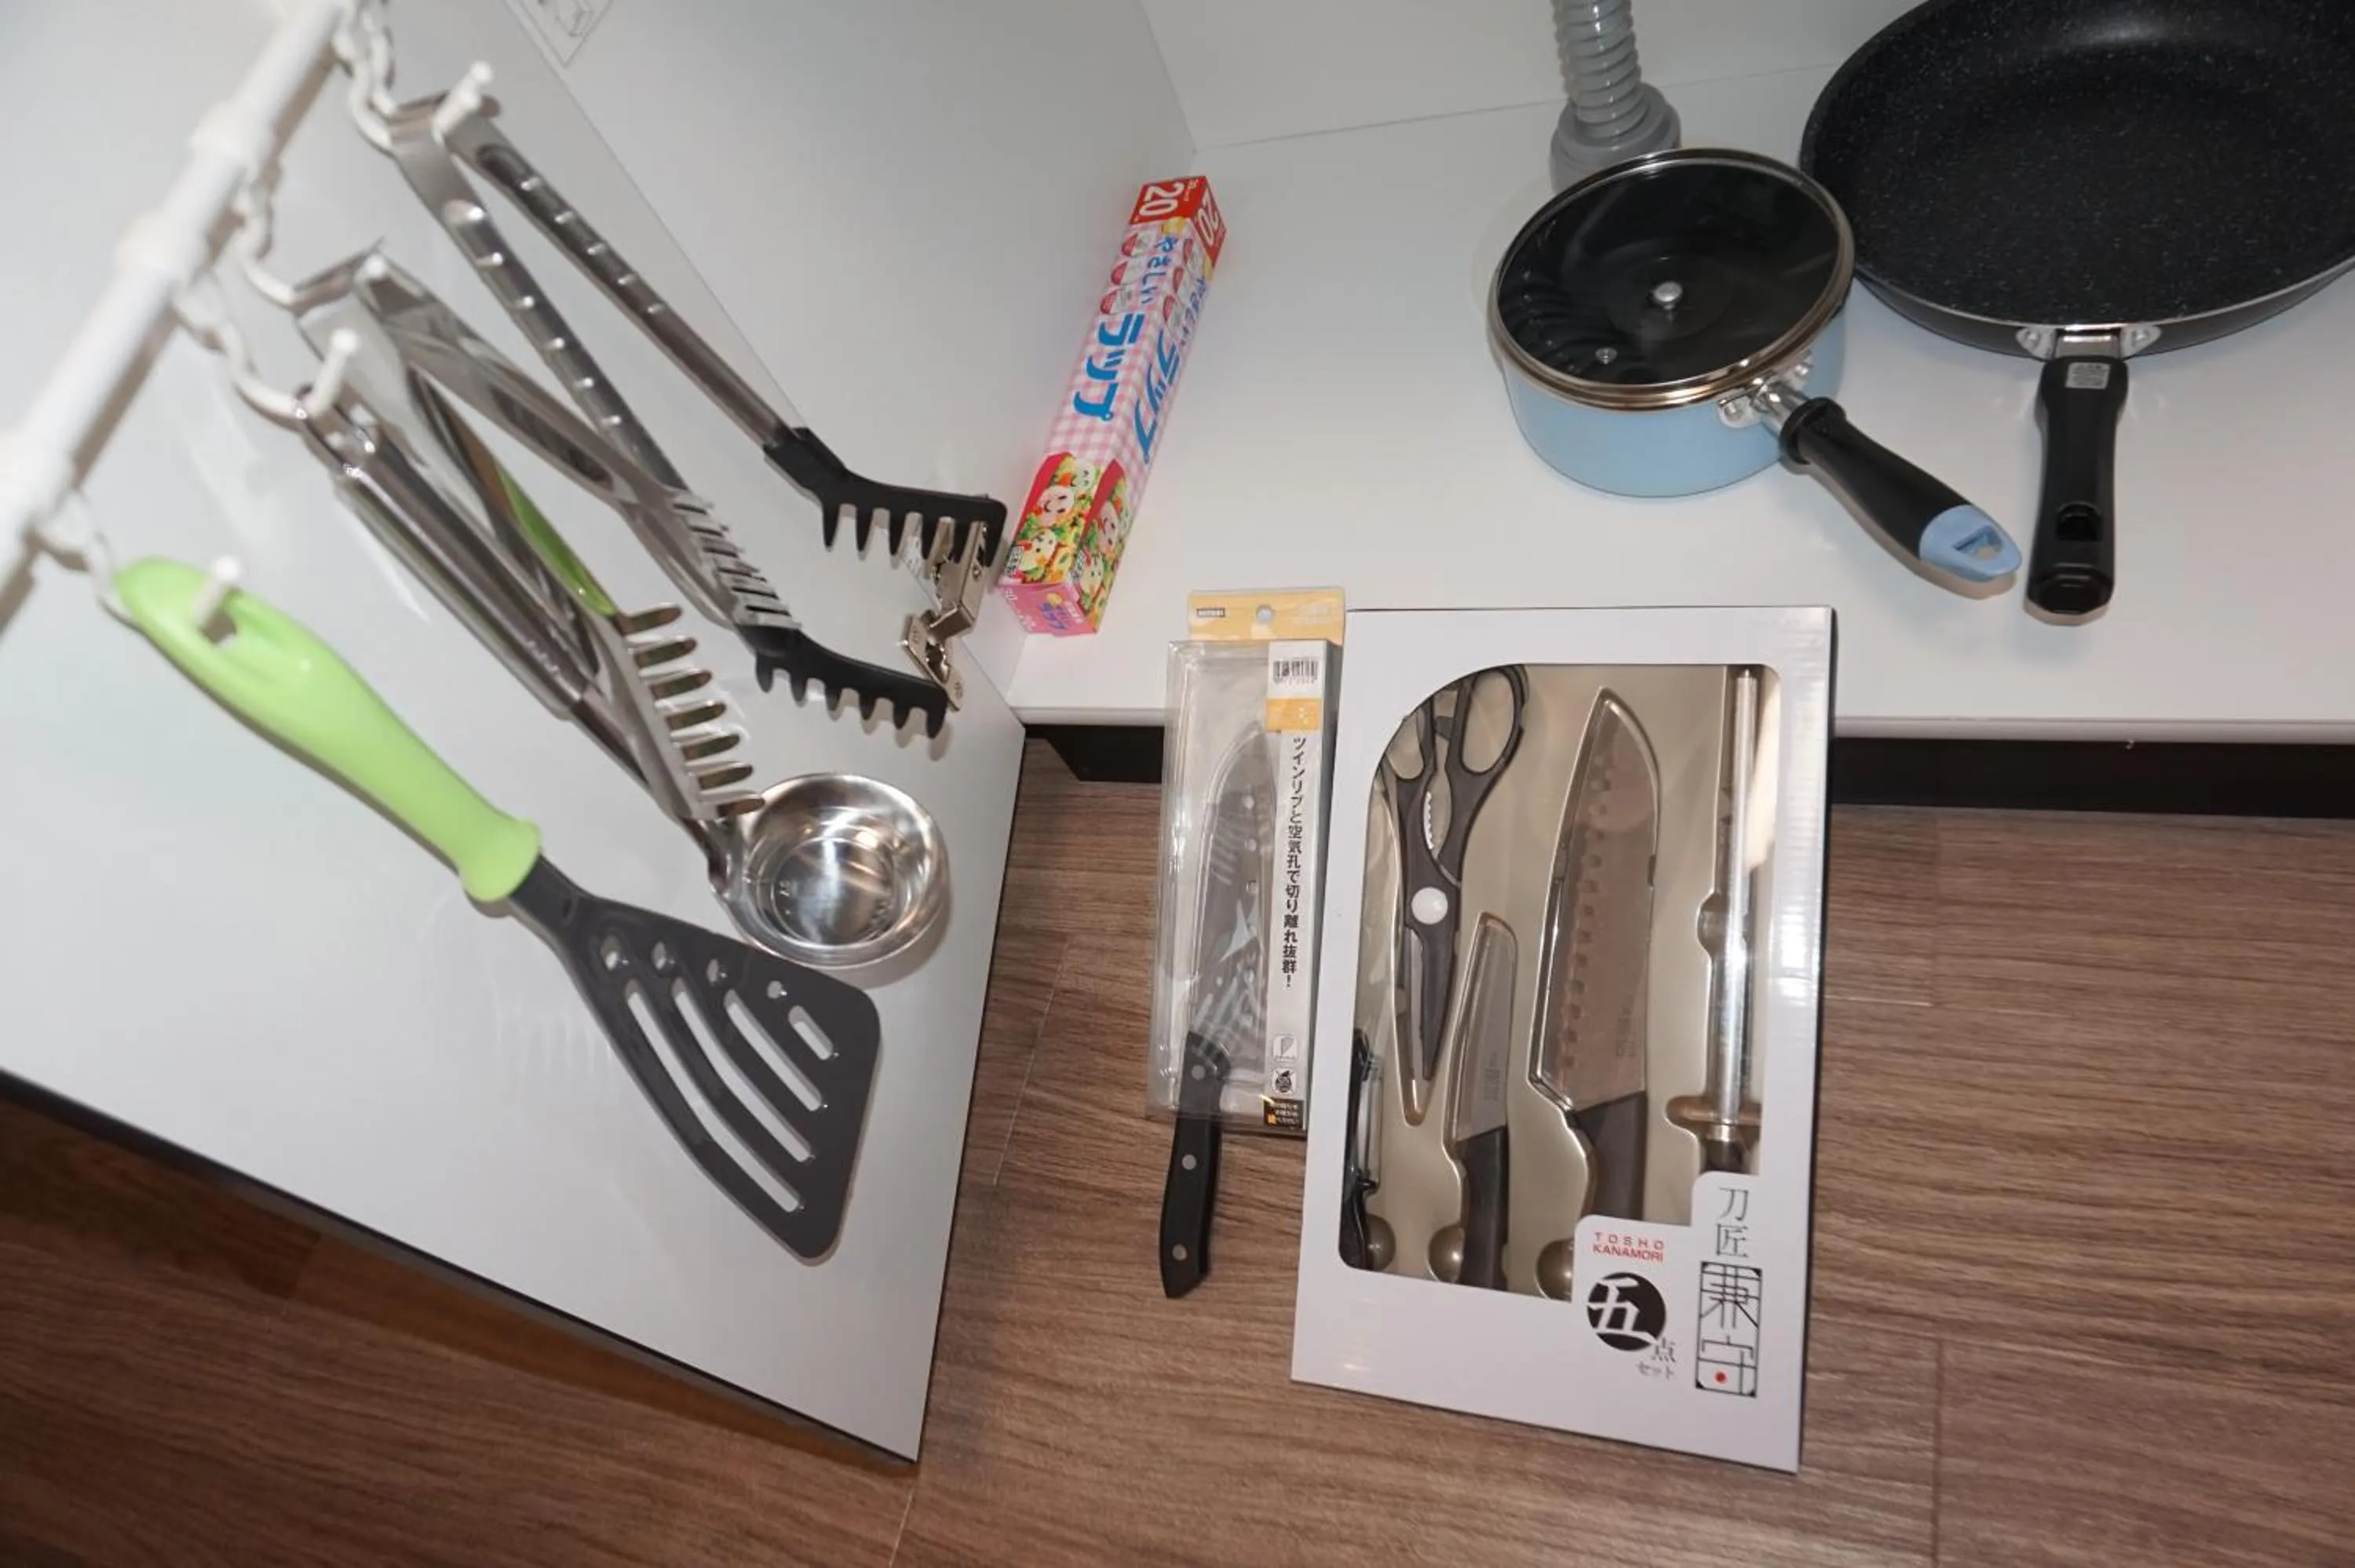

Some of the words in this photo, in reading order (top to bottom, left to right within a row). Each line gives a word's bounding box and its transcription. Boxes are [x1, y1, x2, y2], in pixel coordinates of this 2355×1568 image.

[1139, 183, 1185, 216] 20
[1197, 187, 1218, 247] 20
[1593, 1243, 1664, 1263] KANAMORI
[1594, 1231, 1664, 1250] TOSHO
